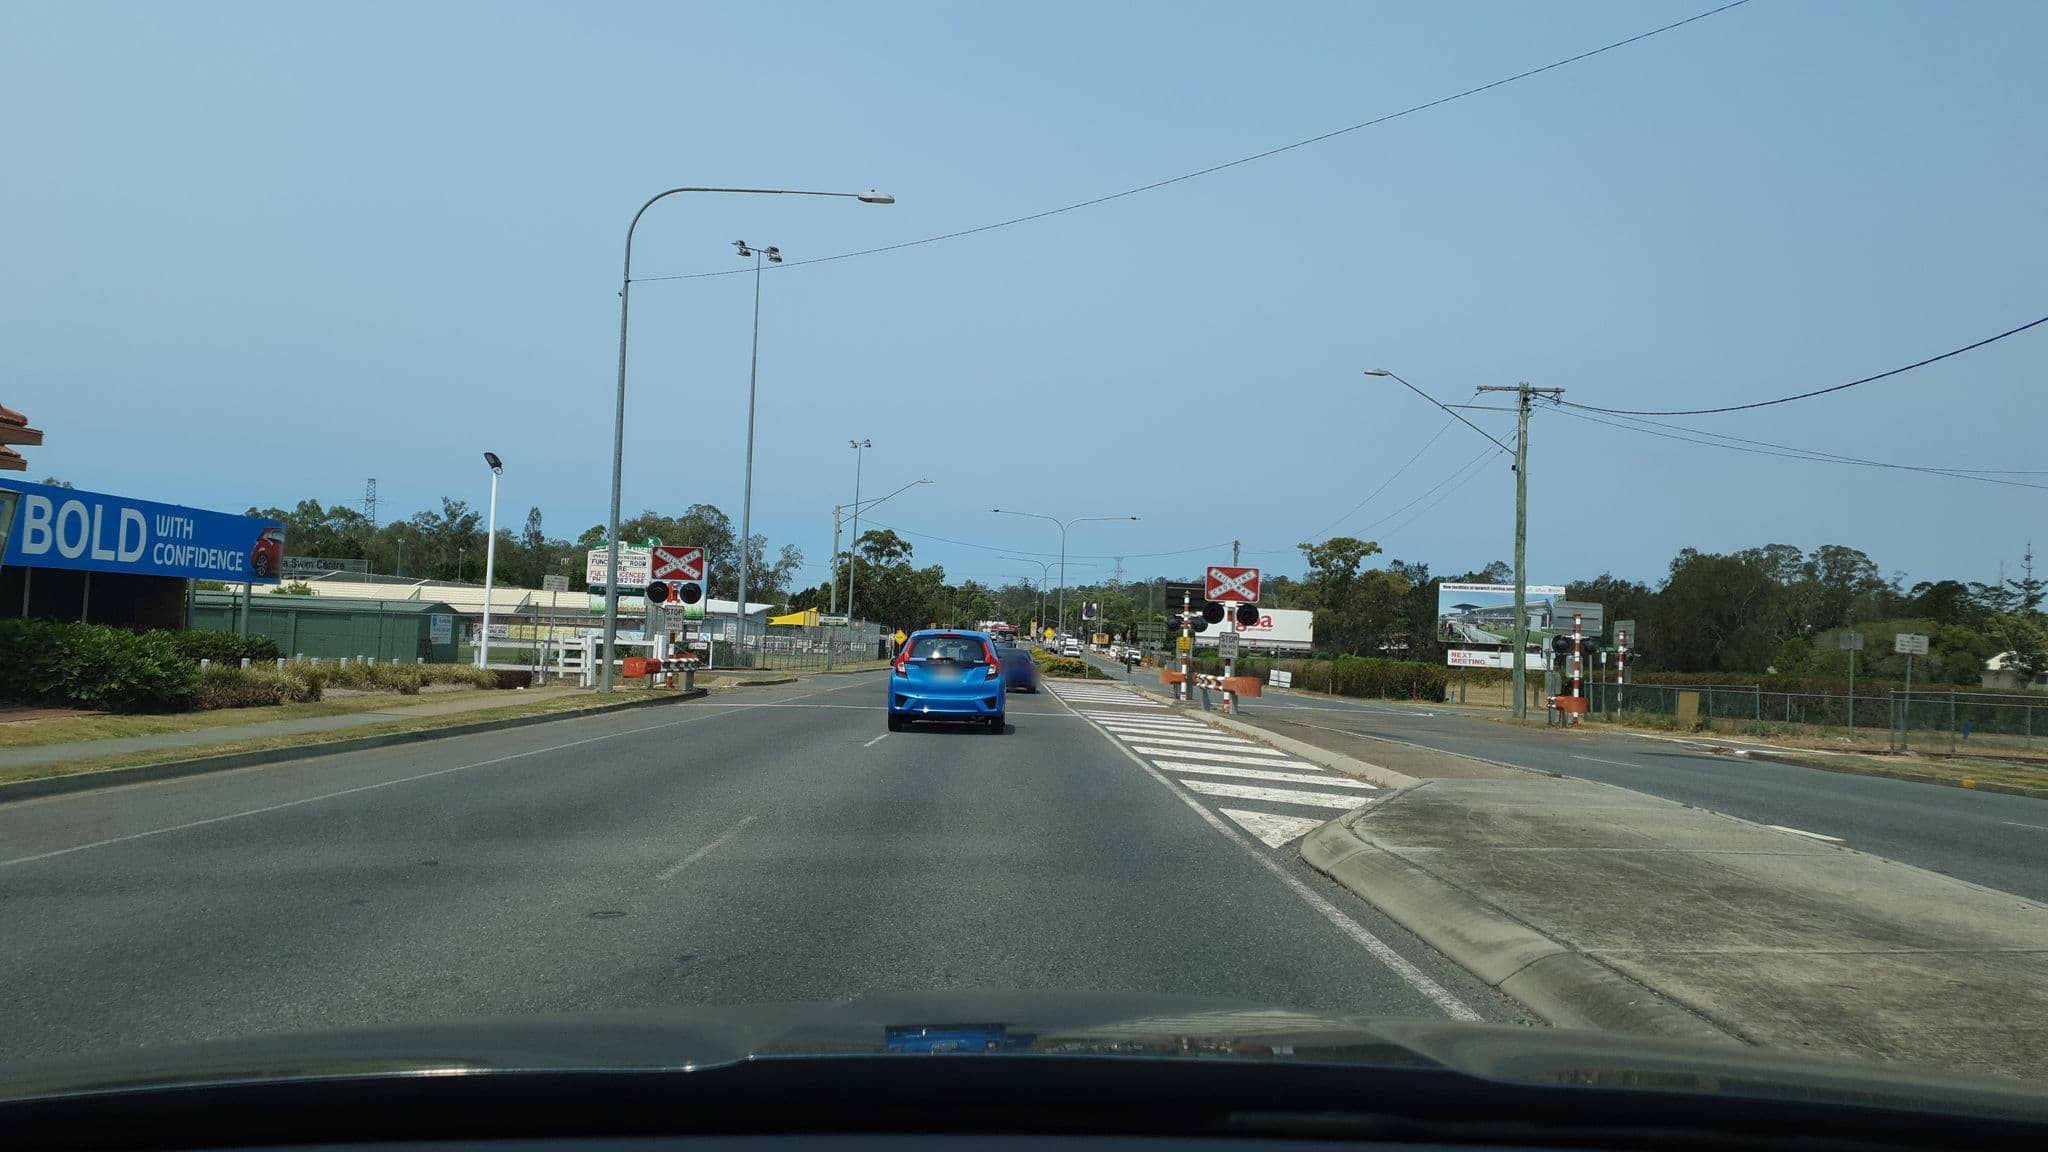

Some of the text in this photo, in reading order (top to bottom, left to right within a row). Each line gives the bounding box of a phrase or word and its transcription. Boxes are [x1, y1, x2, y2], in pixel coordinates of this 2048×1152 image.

[21, 495, 147, 563] BOLD
[156, 514, 193, 540] WITH
[153, 543, 244, 572] CONFIDENCE
[591, 559, 622, 567] FUNCN
[291, 558, 315, 569] Swim
[316, 560, 345, 570] Centre
[666, 608, 682, 616] STOP
[1220, 635, 1238, 643] STOP
